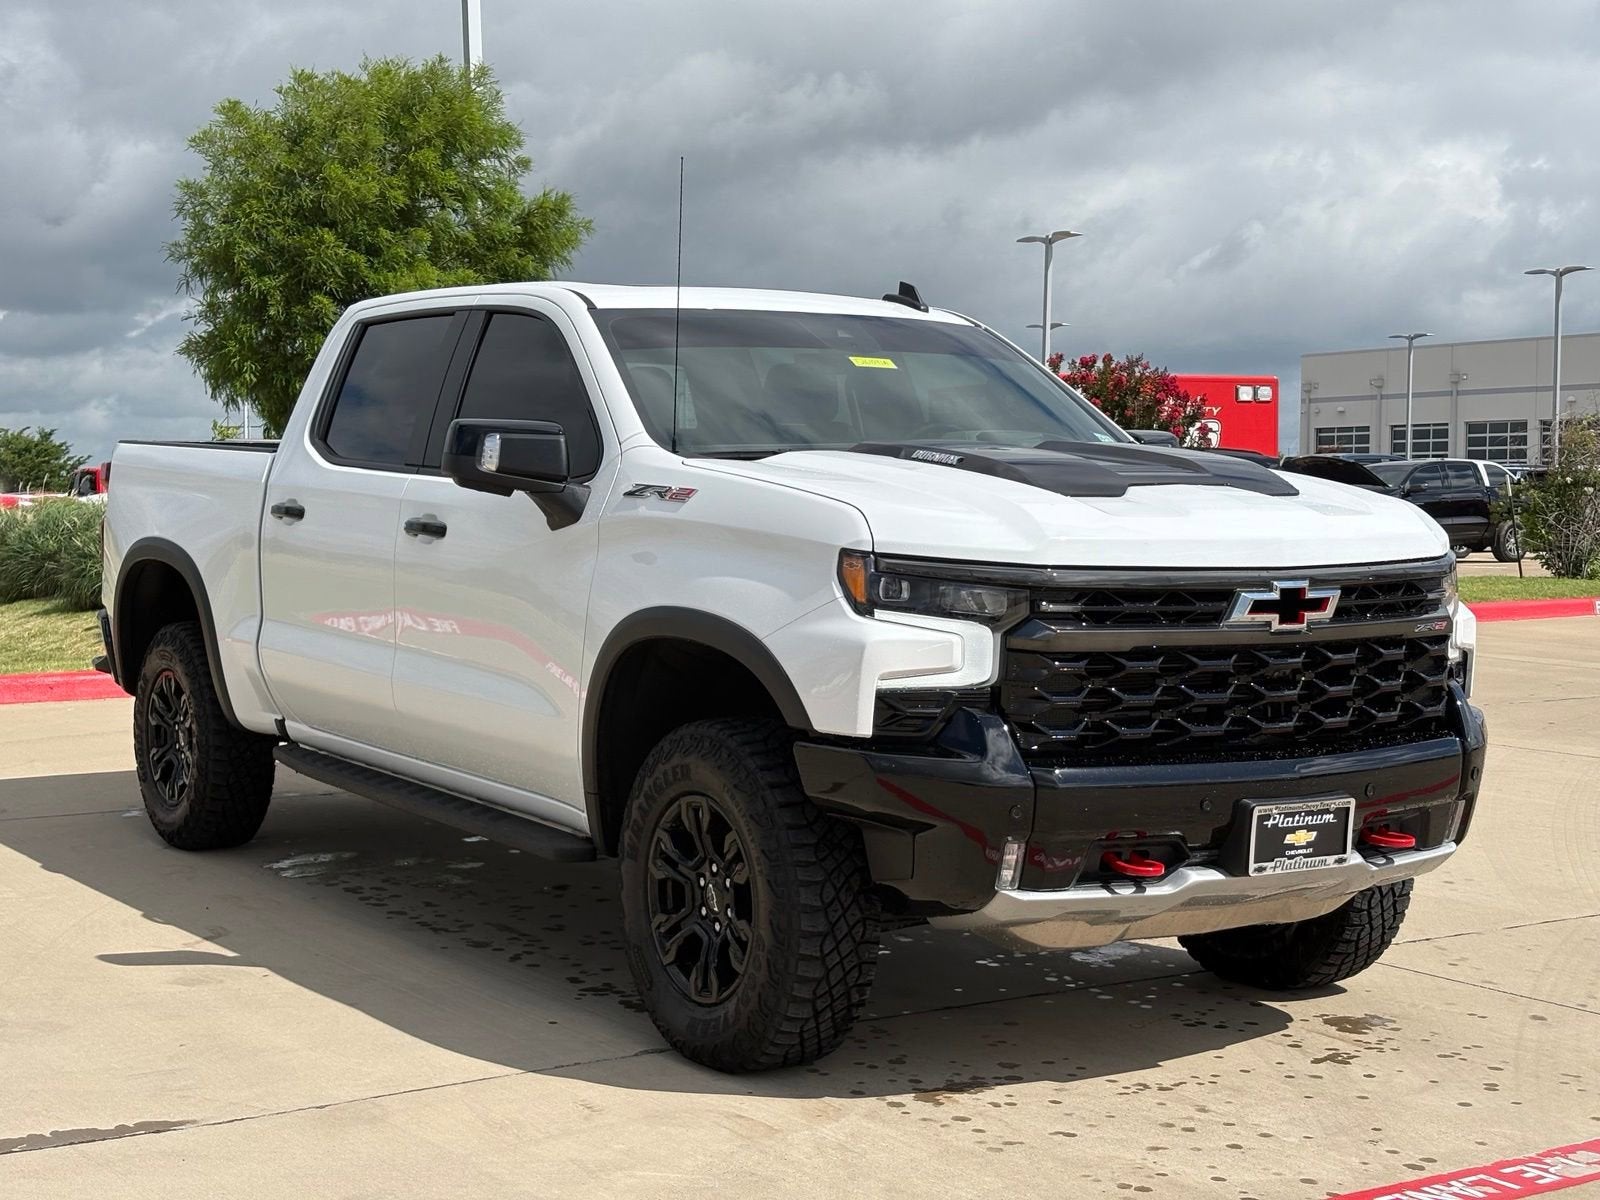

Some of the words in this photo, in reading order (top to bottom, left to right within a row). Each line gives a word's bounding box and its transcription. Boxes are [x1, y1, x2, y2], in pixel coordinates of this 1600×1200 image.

[622, 483, 699, 503] ZR2
[1414, 620, 1448, 633] ZR2
[1263, 812, 1337, 828] Platinum
[1285, 847, 1314, 856] CHEVROLET
[1269, 856, 1332, 872] Platinum
